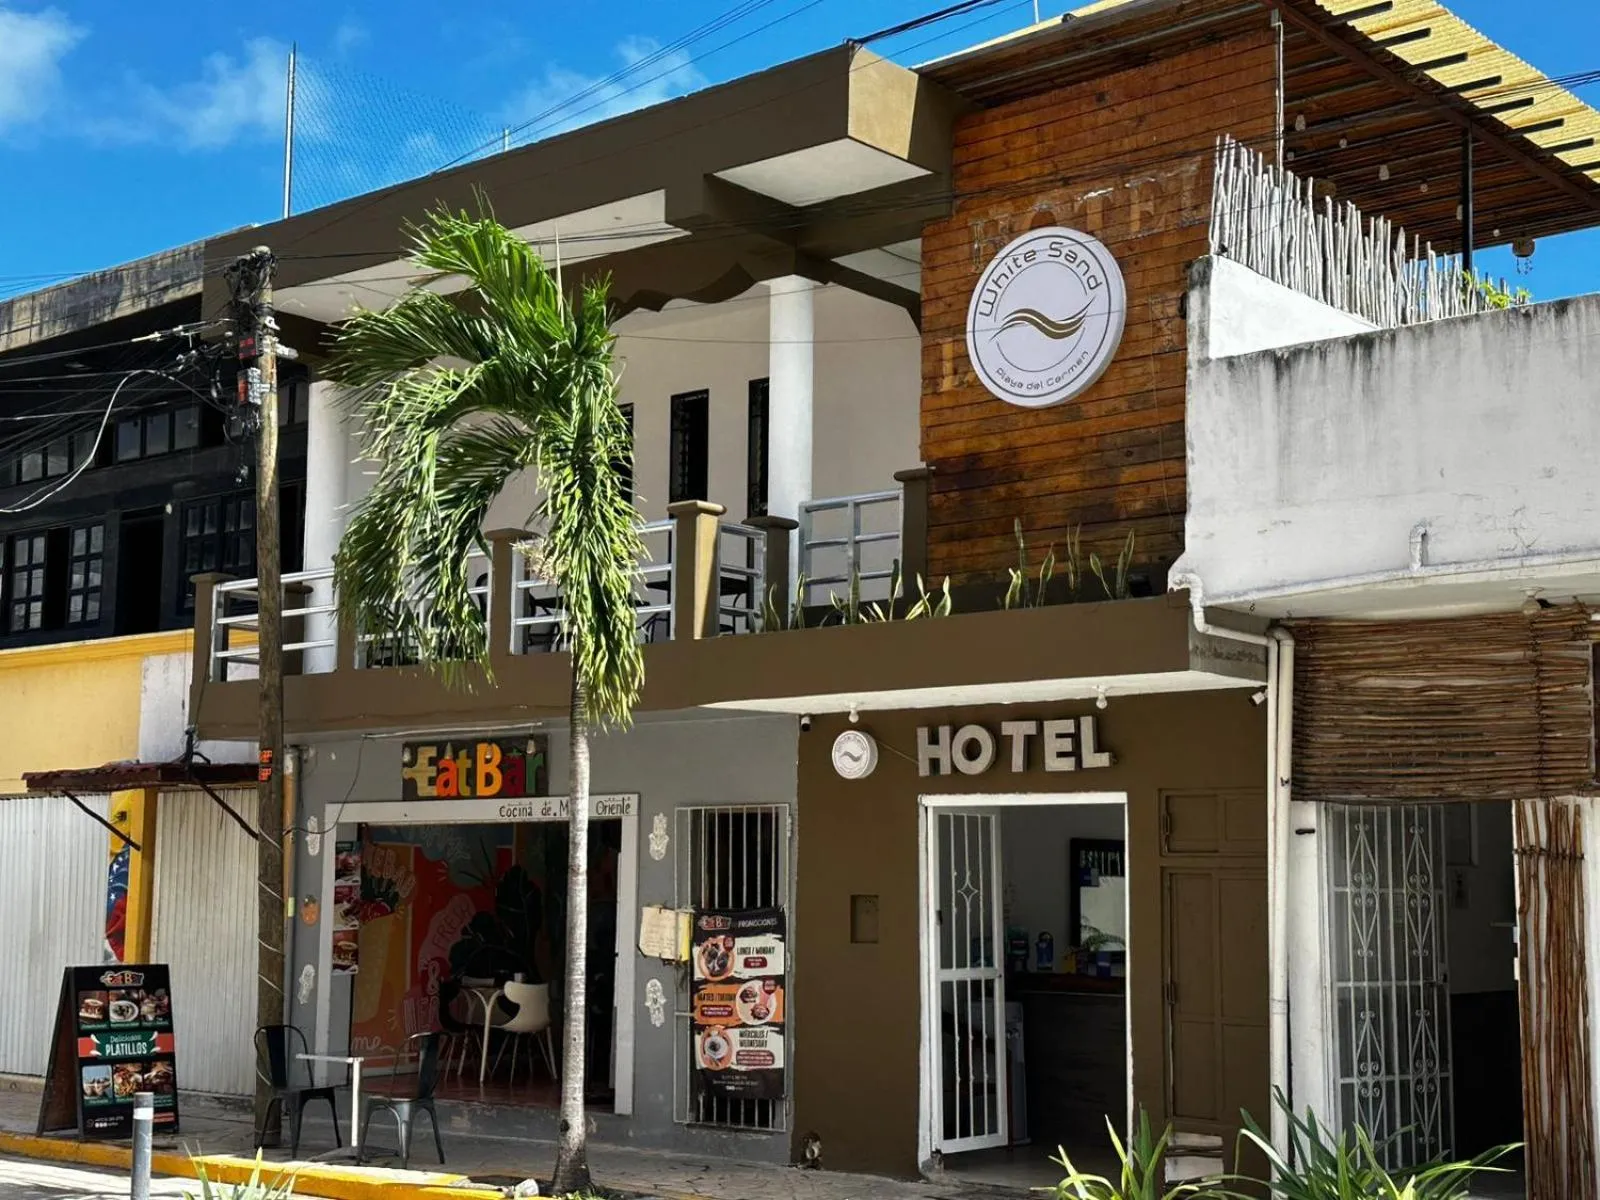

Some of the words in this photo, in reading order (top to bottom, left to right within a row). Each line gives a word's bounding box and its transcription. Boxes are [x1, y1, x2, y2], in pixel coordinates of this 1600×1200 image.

[979, 247, 1037, 317] White
[1048, 241, 1103, 290] Sand
[995, 367, 1023, 389] Playa
[1027, 380, 1044, 391] del
[1047, 350, 1090, 385] Carmen
[917, 715, 1113, 777] HOTEL
[402, 744, 472, 797] Eat
[476, 743, 543, 797] Bar
[499, 802, 533, 818] Cocina
[595, 798, 632, 816] Oriente
[105, 1042, 148, 1056] PLATILLOS
